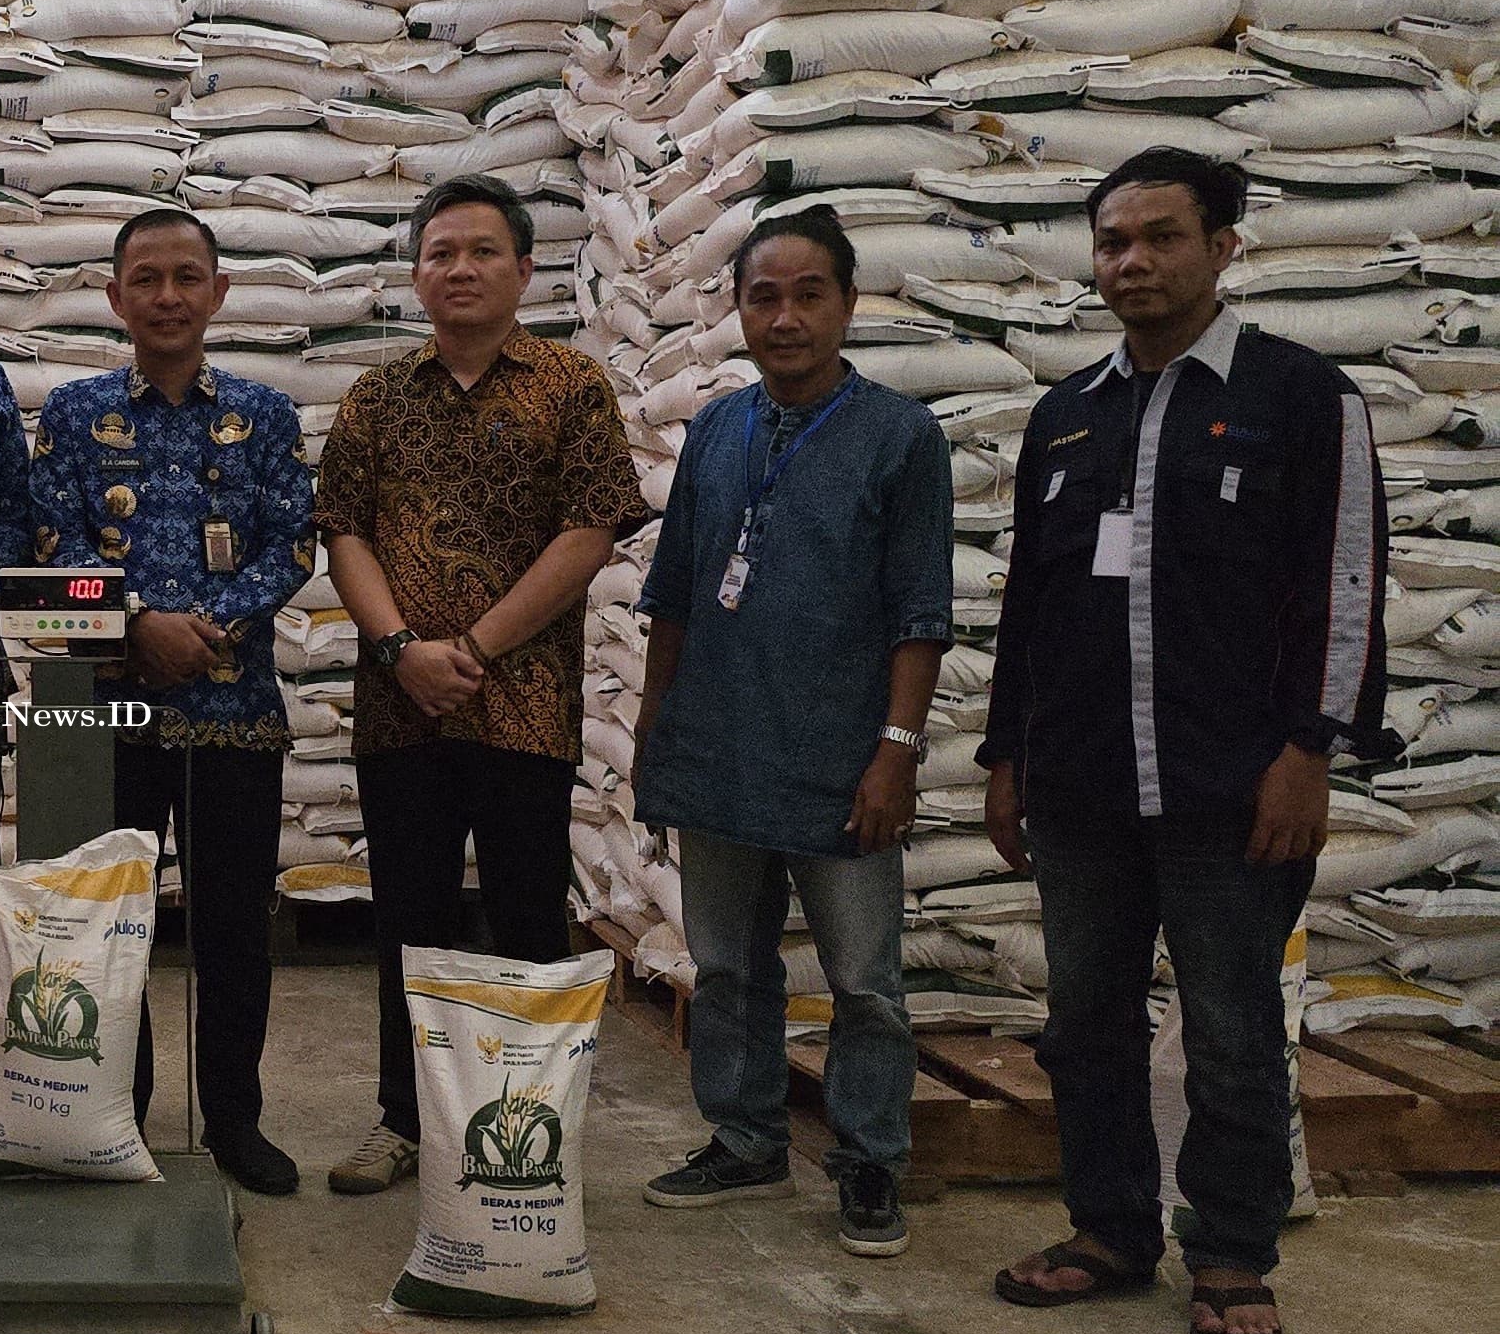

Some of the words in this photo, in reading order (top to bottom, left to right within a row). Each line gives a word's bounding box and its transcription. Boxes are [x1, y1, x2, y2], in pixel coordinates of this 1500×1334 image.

[68, 579, 104, 599] 10.0
[3, 1069, 40, 1087] BERAS
[43, 1080, 89, 1093] MEDIUM
[27, 1093, 45, 1110] 10
[50, 1098, 71, 1117] kg
[480, 1196, 521, 1209] BERAS
[524, 1196, 564, 1209] MEDIUM
[510, 1215, 533, 1233] 10
[537, 1215, 556, 1235] kg
